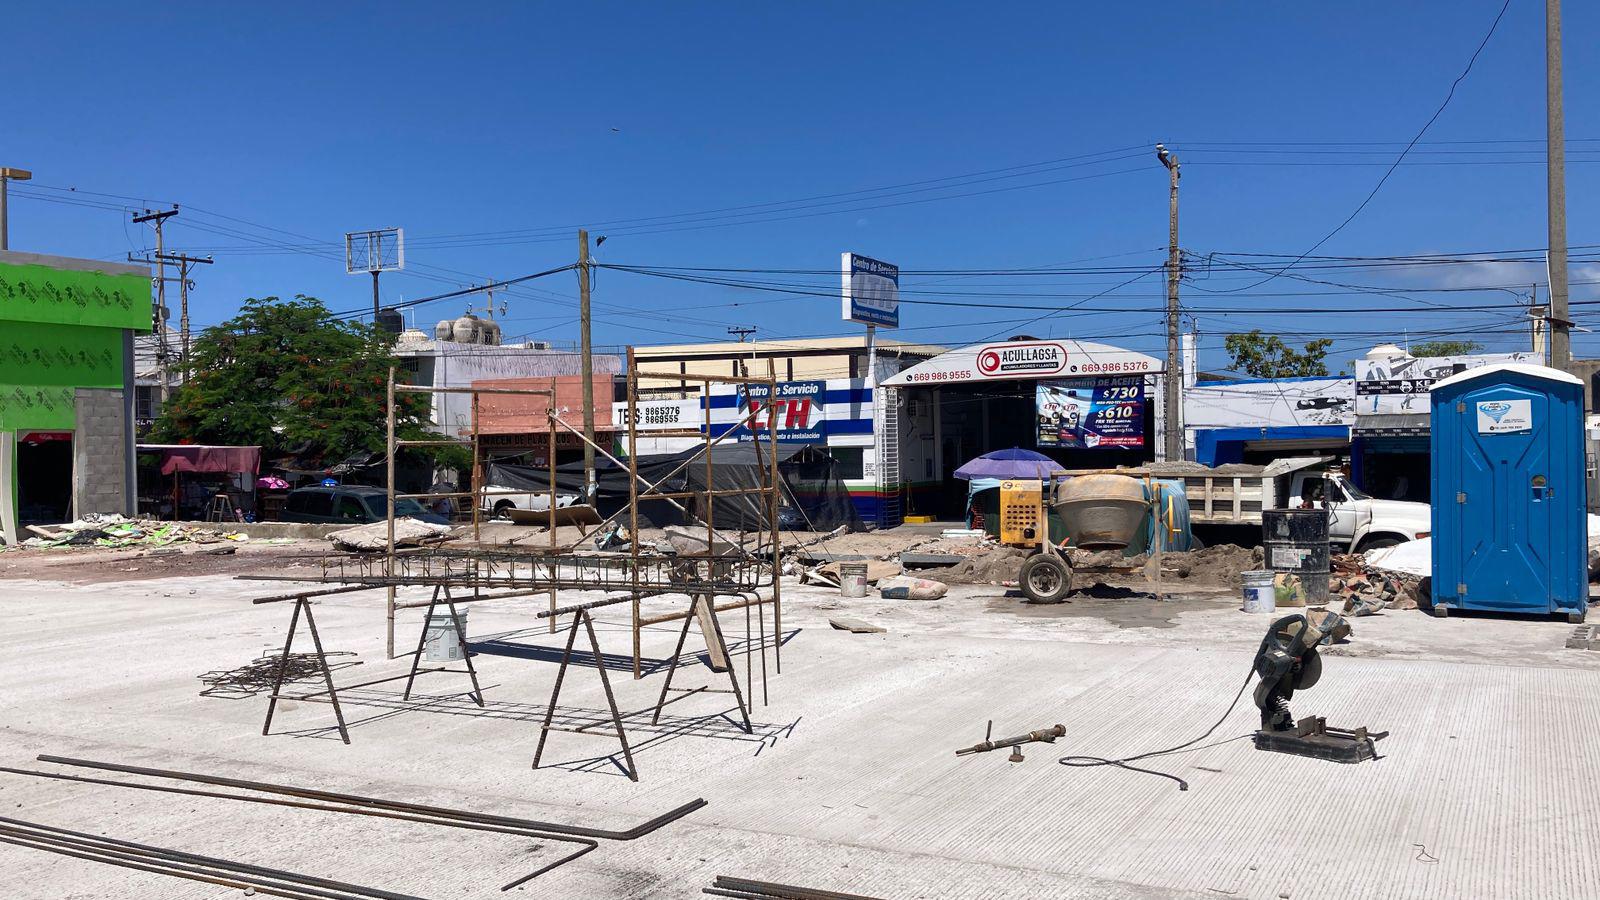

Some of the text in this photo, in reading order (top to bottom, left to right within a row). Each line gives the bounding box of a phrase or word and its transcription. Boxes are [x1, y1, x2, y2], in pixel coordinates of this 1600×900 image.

[852, 256, 897, 277] Centro de Servicio
[1002, 348, 1058, 362] ACULLAGSA
[1082, 362, 1148, 372] 669 986 5376
[914, 370, 971, 382] 669 986 9555
[740, 386, 768, 396] Cntro
[782, 383, 819, 395] Servicio
[1103, 386, 1138, 399] $730
[618, 406, 680, 424] TES: 9865376
[748, 398, 811, 428] LTH
[1097, 406, 1132, 418] $610
[515, 434, 524, 444] DE
[528, 433, 571, 444] PLASCOS
